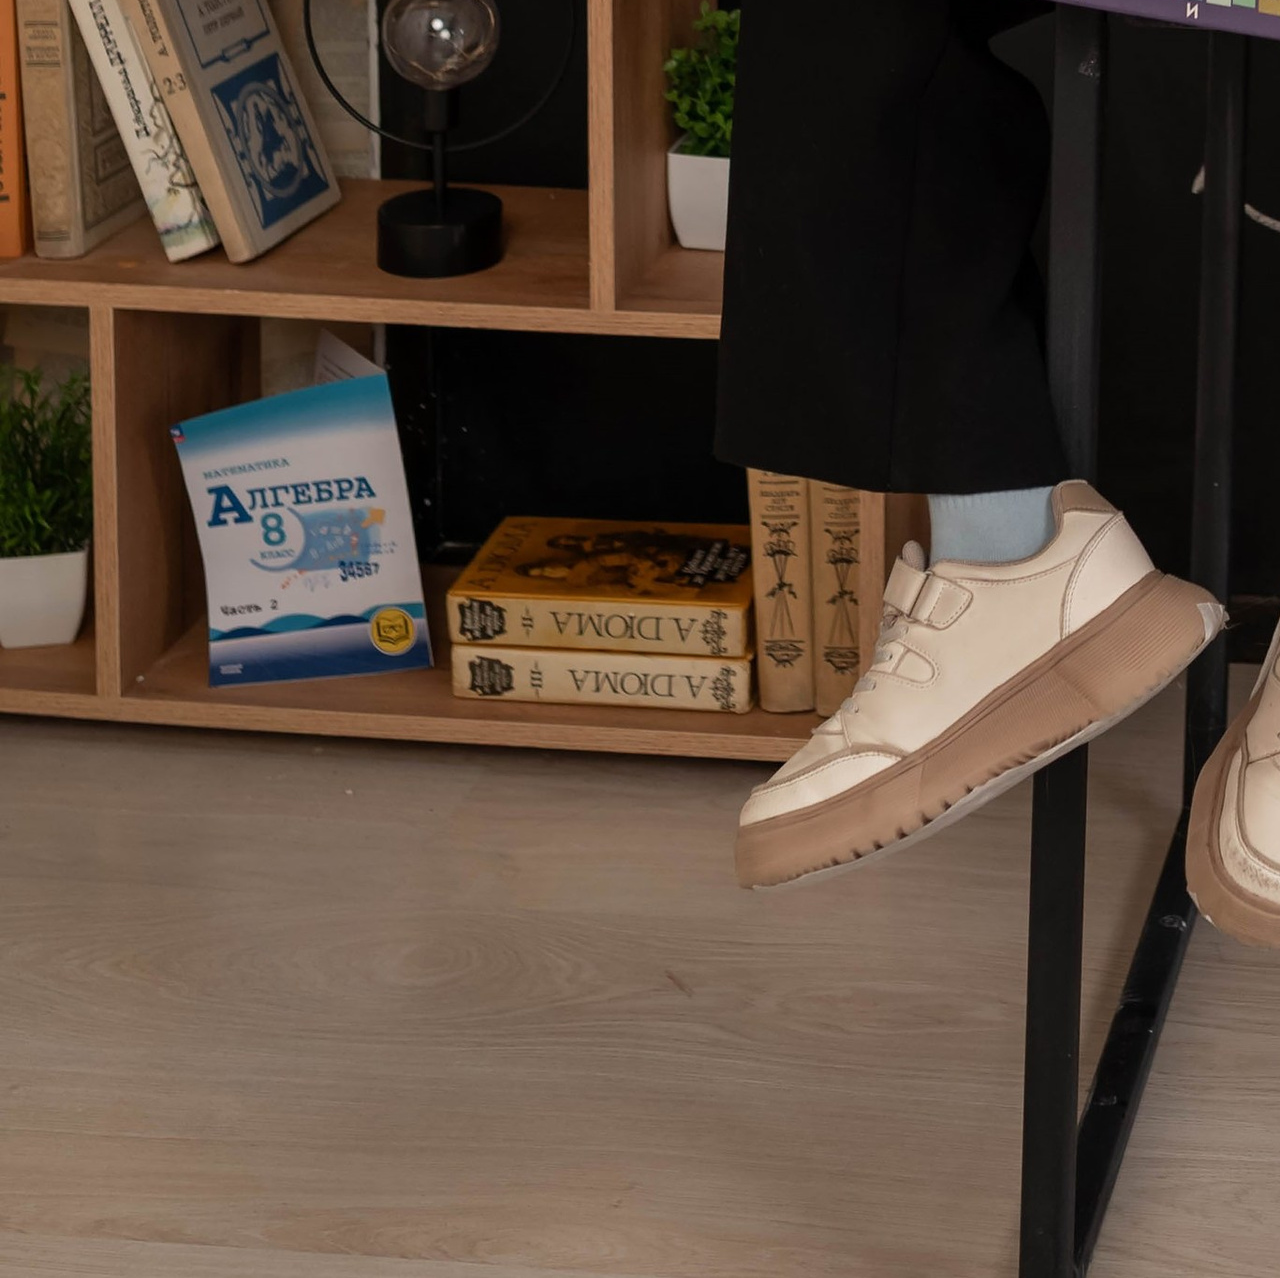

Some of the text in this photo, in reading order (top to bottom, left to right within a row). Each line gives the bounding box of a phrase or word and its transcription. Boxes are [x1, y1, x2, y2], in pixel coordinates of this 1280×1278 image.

[202, 457, 290, 481] МАТЕМАТИКА
[206, 476, 378, 529] АЛГЕБРА
[261, 511, 286, 547] 8
[259, 548, 296, 561] КЛАСС
[549, 610, 663, 642] ДЮМА
[567, 668, 675, 699] ДЮМА
